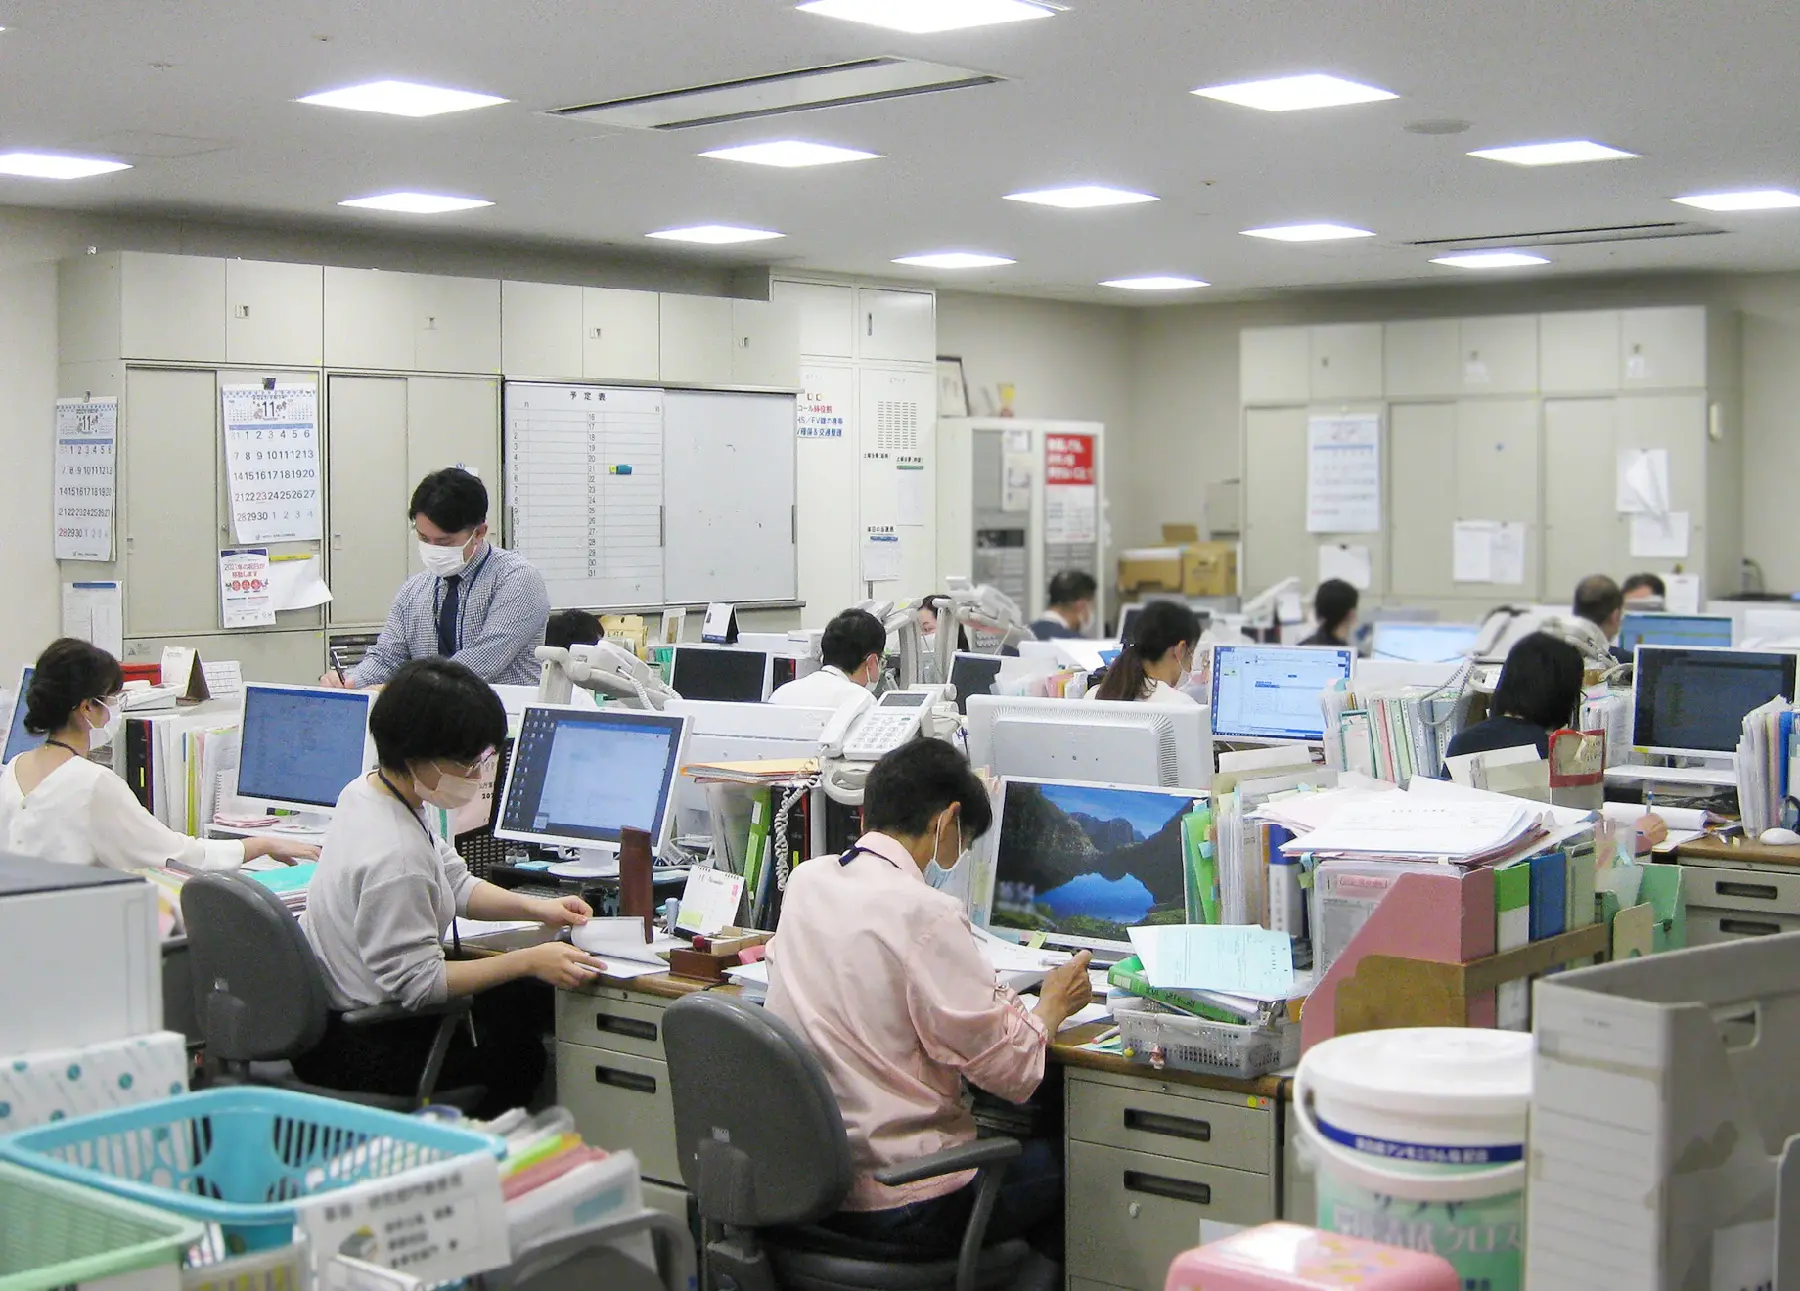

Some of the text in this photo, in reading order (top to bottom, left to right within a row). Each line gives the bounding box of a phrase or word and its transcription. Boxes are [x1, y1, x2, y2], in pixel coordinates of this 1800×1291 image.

[570, 391, 606, 401] 予定表
[262, 401, 276, 417] 11
[82, 415, 91, 431] 11
[246, 431, 249, 439] 1
[256, 431, 262, 439] 2
[280, 430, 286, 438] 4
[292, 430, 297, 438] 5
[304, 429, 310, 438] 6
[70, 446, 74, 454] 1
[77, 446, 82, 454] 2
[85, 446, 89, 454] 3
[93, 446, 97, 454] 4
[100, 446, 105, 454] 5
[108, 446, 112, 454] 6
[245, 452, 250, 460] 8
[267, 451, 277, 459] 10
[291, 450, 301, 458] 12
[303, 450, 314, 458] 13
[245, 472, 254, 480] 15
[256, 471, 266, 479] 16
[268, 471, 278, 479] 17
[280, 470, 291, 479] 18
[292, 469, 302, 478] 19
[302, 469, 314, 478] 20
[235, 490, 315, 501] 21 22 23 24 25 26 27
[237, 513, 246, 522] 28
[247, 512, 256, 521] 29
[257, 512, 268, 520] 30
